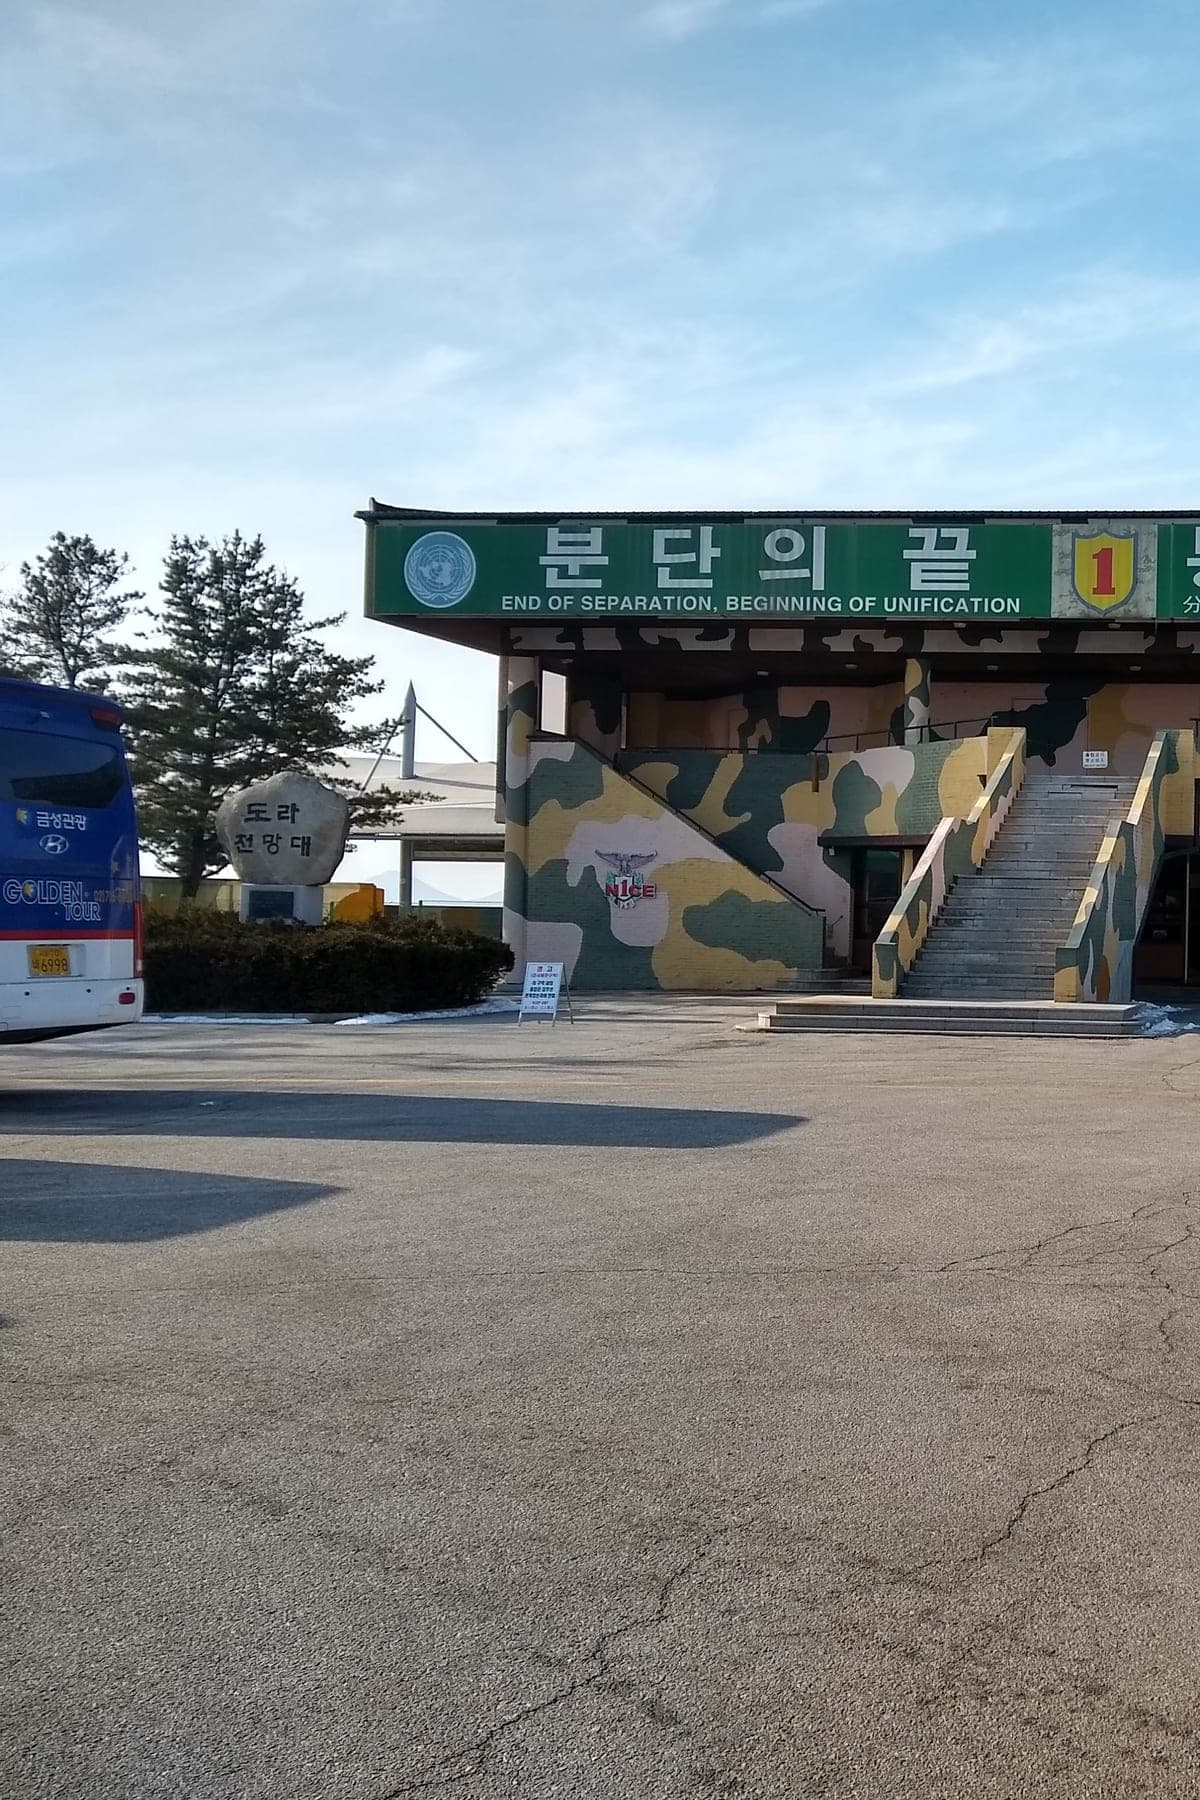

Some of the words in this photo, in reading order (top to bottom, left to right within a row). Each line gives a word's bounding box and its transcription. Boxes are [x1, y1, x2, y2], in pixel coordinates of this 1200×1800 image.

[903, 527, 977, 591] 끝
[1092, 547, 1116, 596] 1
[501, 595, 541, 611] END
[548, 595, 574, 611] OF
[581, 595, 718, 613] SEPARATION,
[726, 596, 842, 613] BEGINNING
[849, 596, 877, 613] OF
[883, 597, 1020, 614] UNIFICATION
[36, 811, 87, 831] 금성관광
[244, 803, 300, 824] 도라
[234, 833, 312, 857] 전망대
[3, 879, 83, 905] GOLDEN
[63, 901, 101, 921] TOUR
